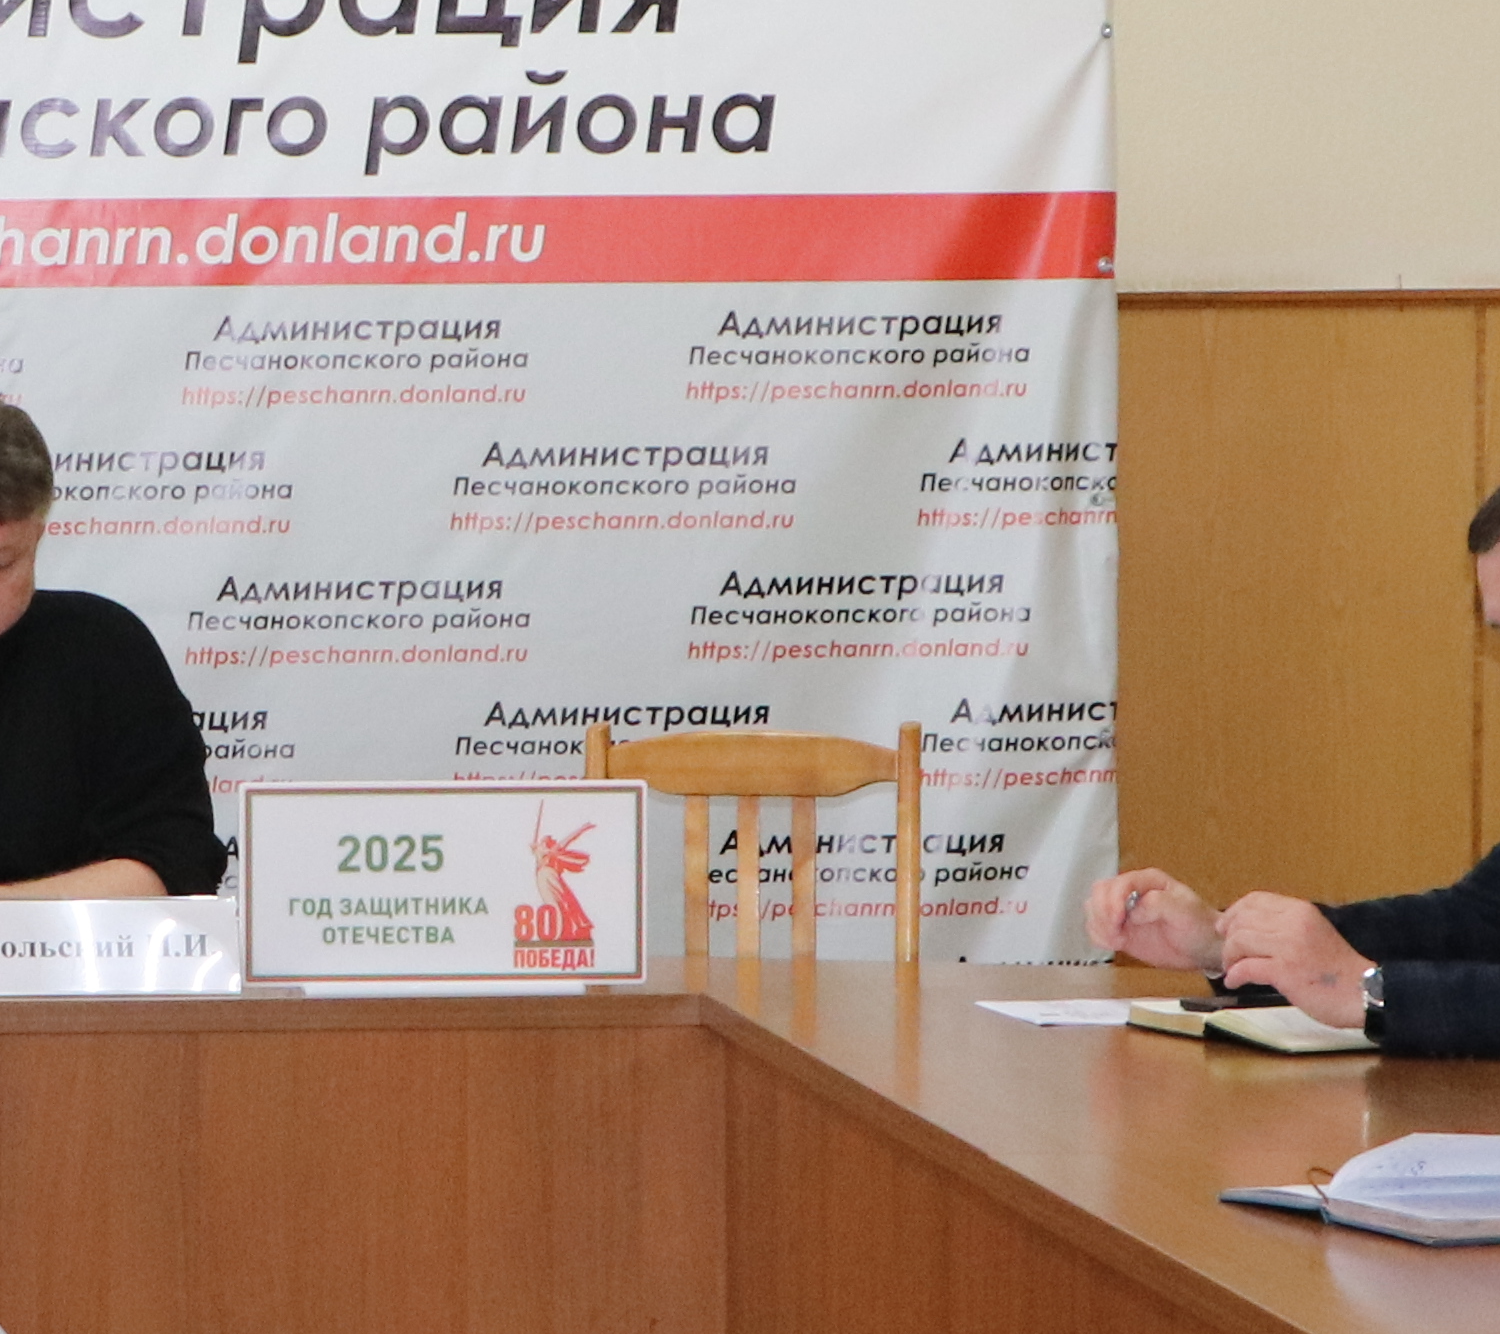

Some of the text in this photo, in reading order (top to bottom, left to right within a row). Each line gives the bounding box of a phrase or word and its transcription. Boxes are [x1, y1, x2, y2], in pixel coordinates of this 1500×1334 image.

[362, 72, 778, 176] района
[214, 316, 501, 345] Администрация
[718, 311, 1002, 340] Администрация
[184, 348, 529, 373] Песчанокопского района
[689, 344, 1030, 367] Песчанокопского района
[182, 385, 526, 409] https://peschanrn.donland.ru
[686, 381, 1027, 403] https://peschanrn.donland.ru
[51, 450, 266, 477] инистрация
[482, 442, 769, 471] Администрация
[194, 479, 292, 504] района
[453, 474, 796, 499] Песчанокопского района
[450, 512, 794, 533] https://peschanrn.donland.ru
[217, 576, 503, 605] Администрация
[720, 570, 1004, 600] Администрация
[188, 608, 530, 633] Песчанокопского района
[933, 602, 1031, 626] района
[185, 645, 528, 668] https://peschanrn.donland.ru
[484, 701, 769, 731] Администрация
[337, 835, 445, 872] 2025
[935, 861, 1030, 886] района
[289, 896, 489, 920] ГОД ЗАЩИТНИКА
[514, 905, 557, 941] 80
[322, 926, 455, 946] ОТЕЧЕСТВА
[513, 949, 596, 970] ПОБЕДА!
